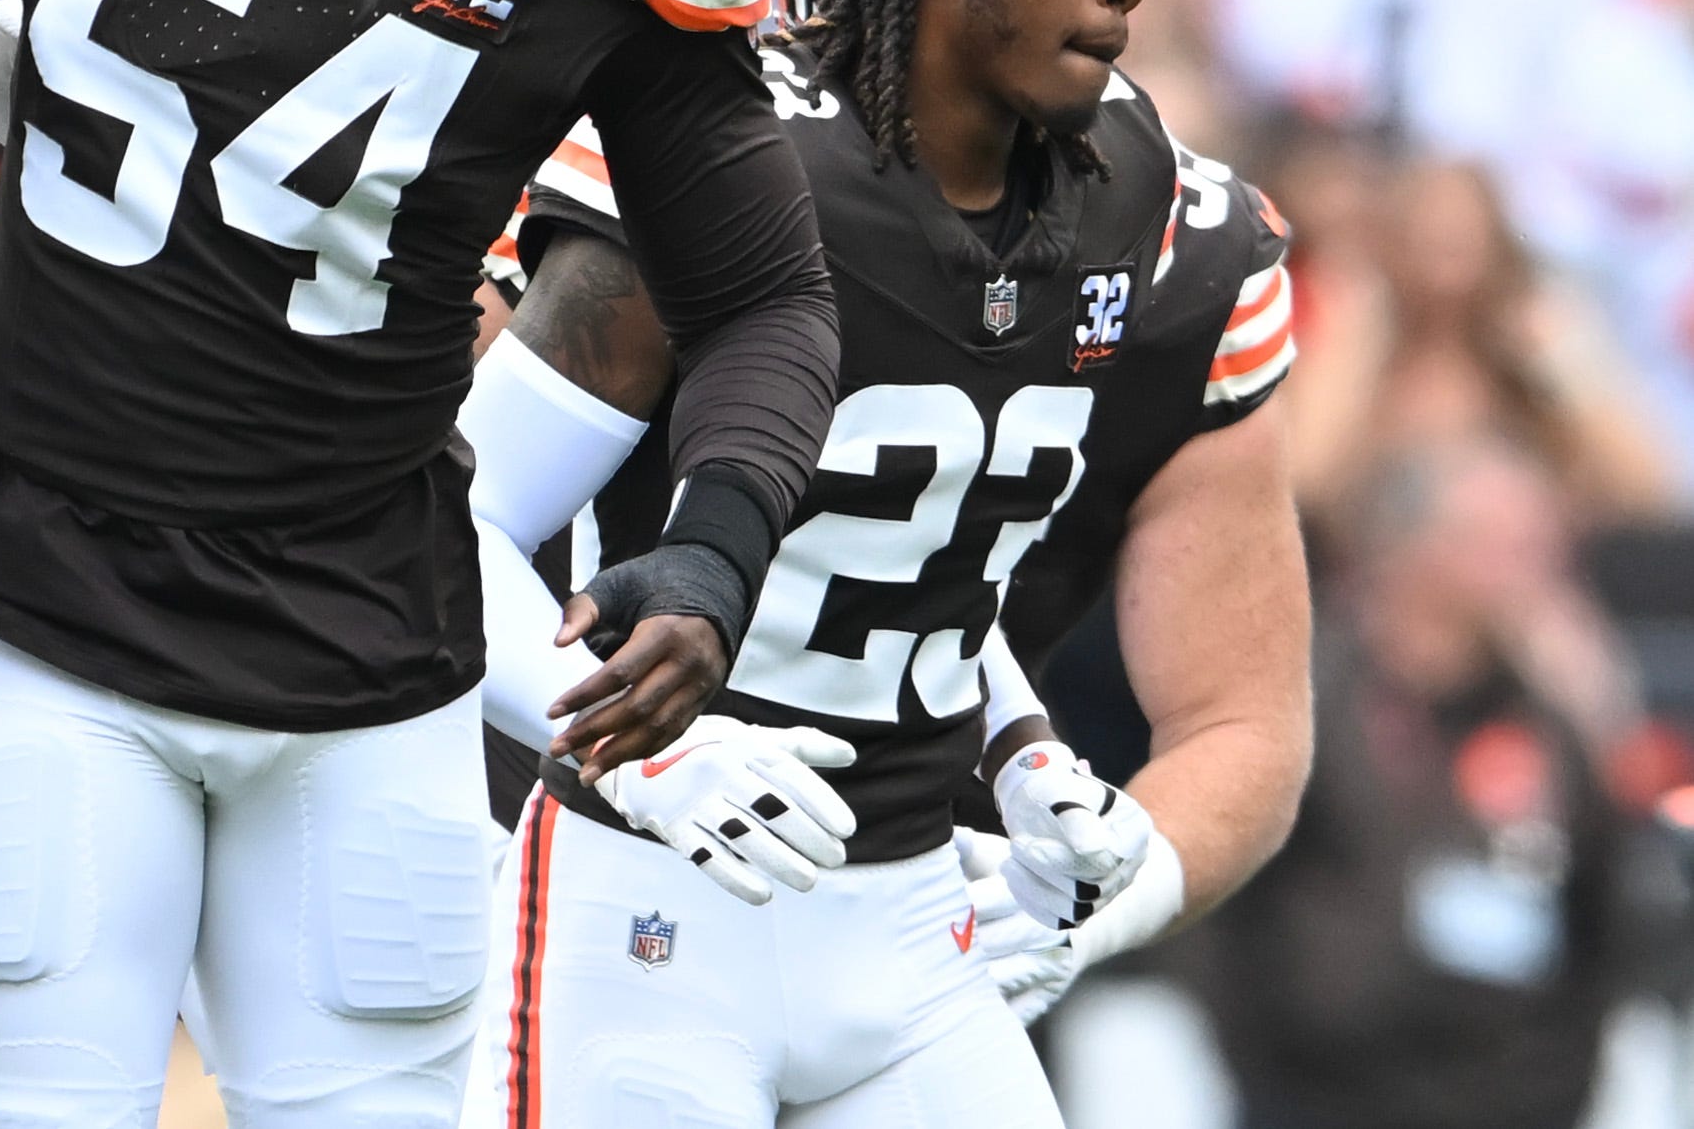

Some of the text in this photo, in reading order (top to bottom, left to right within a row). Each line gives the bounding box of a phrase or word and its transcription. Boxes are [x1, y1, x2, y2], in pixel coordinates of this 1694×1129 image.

[1075, 272, 1131, 346] 32
[726, 383, 1095, 724] 23
[636, 935, 666, 960] NFL
